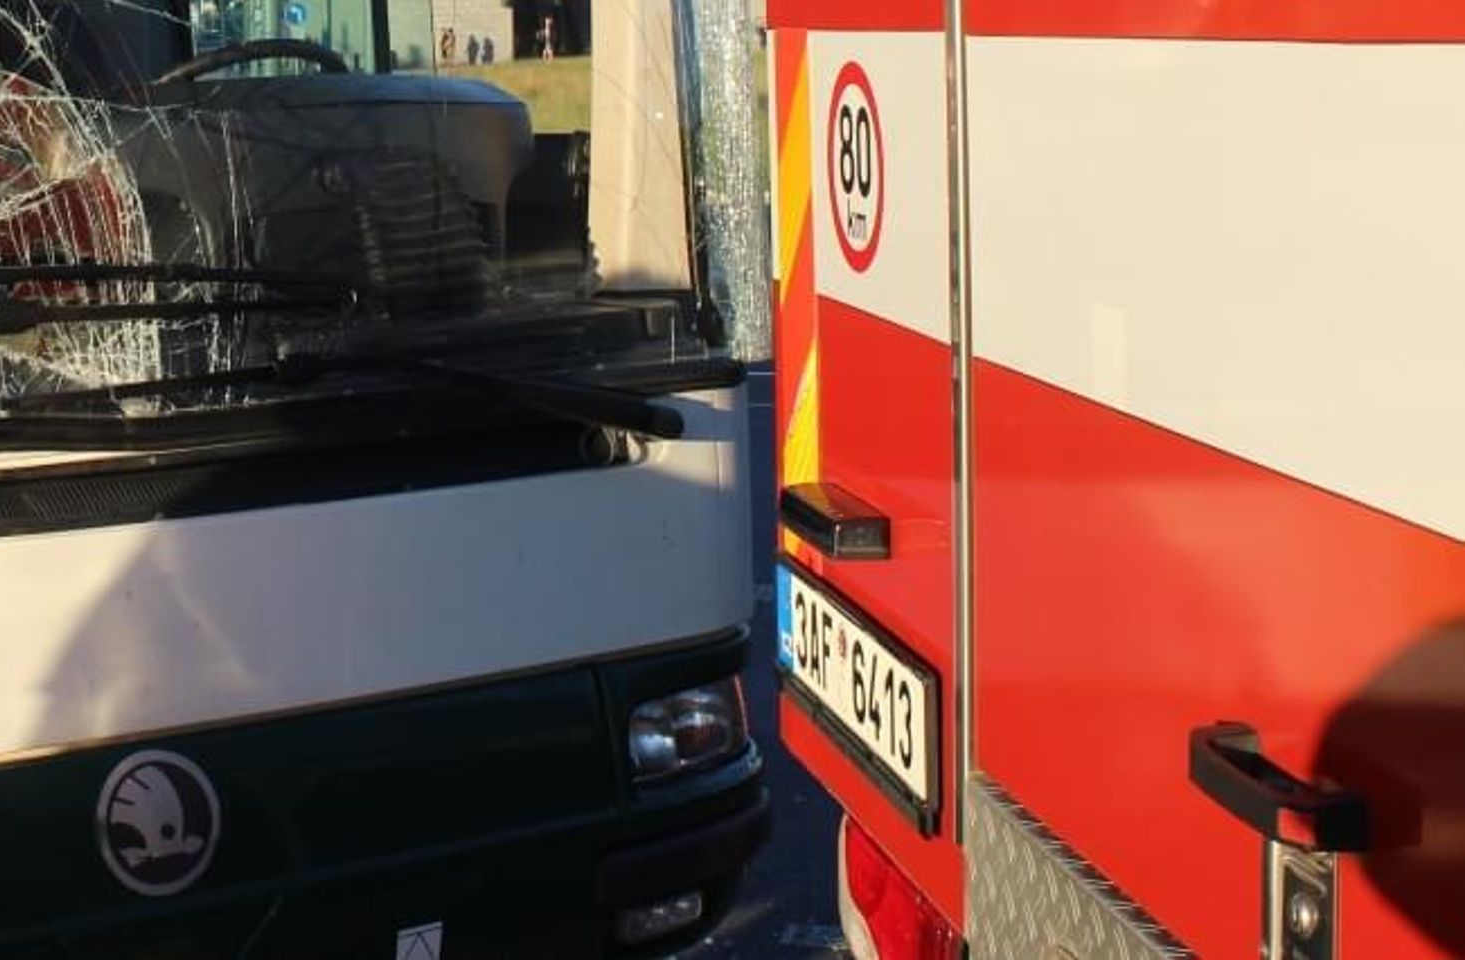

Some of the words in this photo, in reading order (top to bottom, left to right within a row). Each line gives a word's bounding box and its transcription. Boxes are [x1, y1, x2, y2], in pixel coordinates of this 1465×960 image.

[839, 103, 872, 198] 80
[847, 198, 867, 241] km
[795, 591, 833, 688] 3AF
[851, 640, 913, 771] 6413
